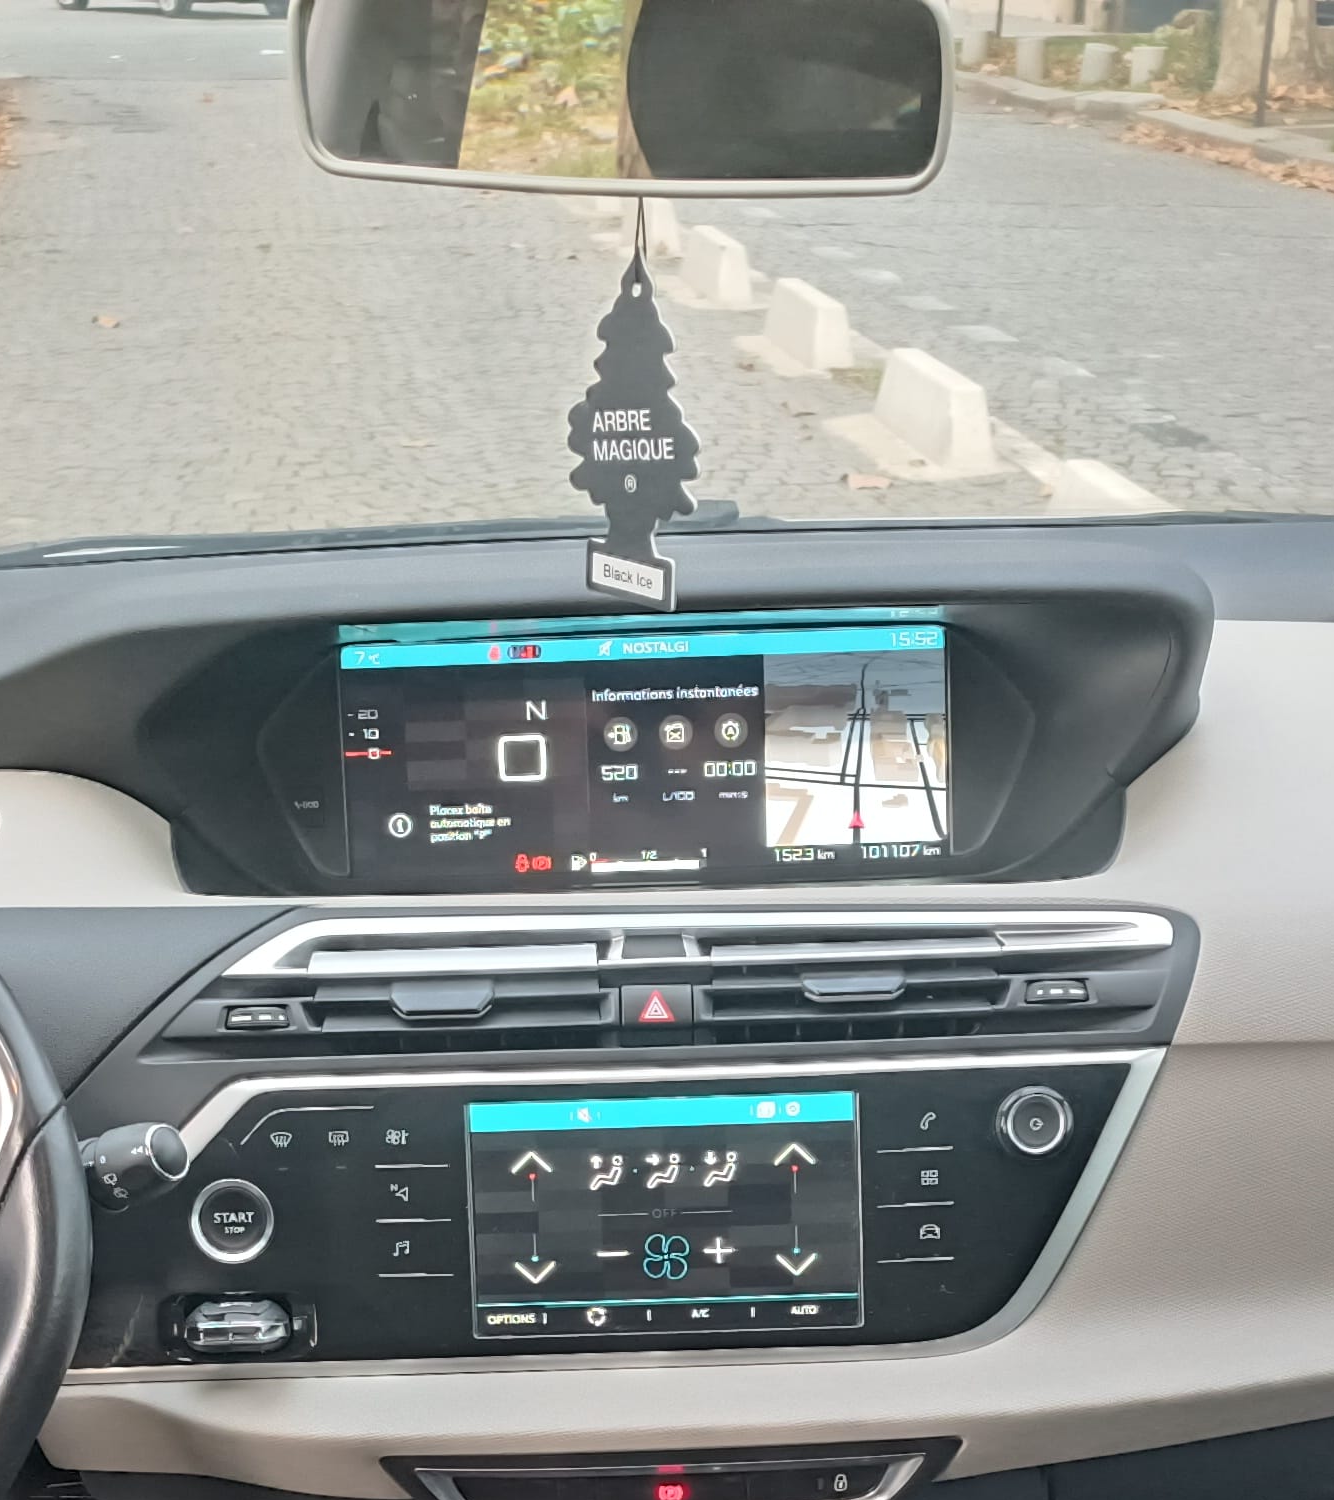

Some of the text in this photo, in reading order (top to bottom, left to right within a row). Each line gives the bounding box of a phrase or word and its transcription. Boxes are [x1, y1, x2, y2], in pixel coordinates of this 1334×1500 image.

[592, 410, 652, 432] ARBRE
[593, 438, 675, 461] MAGIQUE
[603, 564, 653, 589] Black Ice
[890, 631, 938, 647] 15:52
[622, 640, 689, 655] NOSTALGI
[354, 651, 365, 665] 7
[591, 684, 760, 702] Informations instantanées
[525, 700, 548, 721] N
[362, 728, 380, 740] 10
[600, 764, 639, 781] 520
[703, 759, 757, 778] 00:00
[640, 850, 658, 860] 1/2
[774, 847, 836, 862] 1523 km
[861, 844, 941, 860] 101107 km
[213, 1211, 255, 1224] START
[651, 1207, 677, 1219] OFF
[224, 1226, 246, 1235] STOP
[790, 1304, 819, 1315] AUTO
[486, 1312, 537, 1325] OPTIONS
